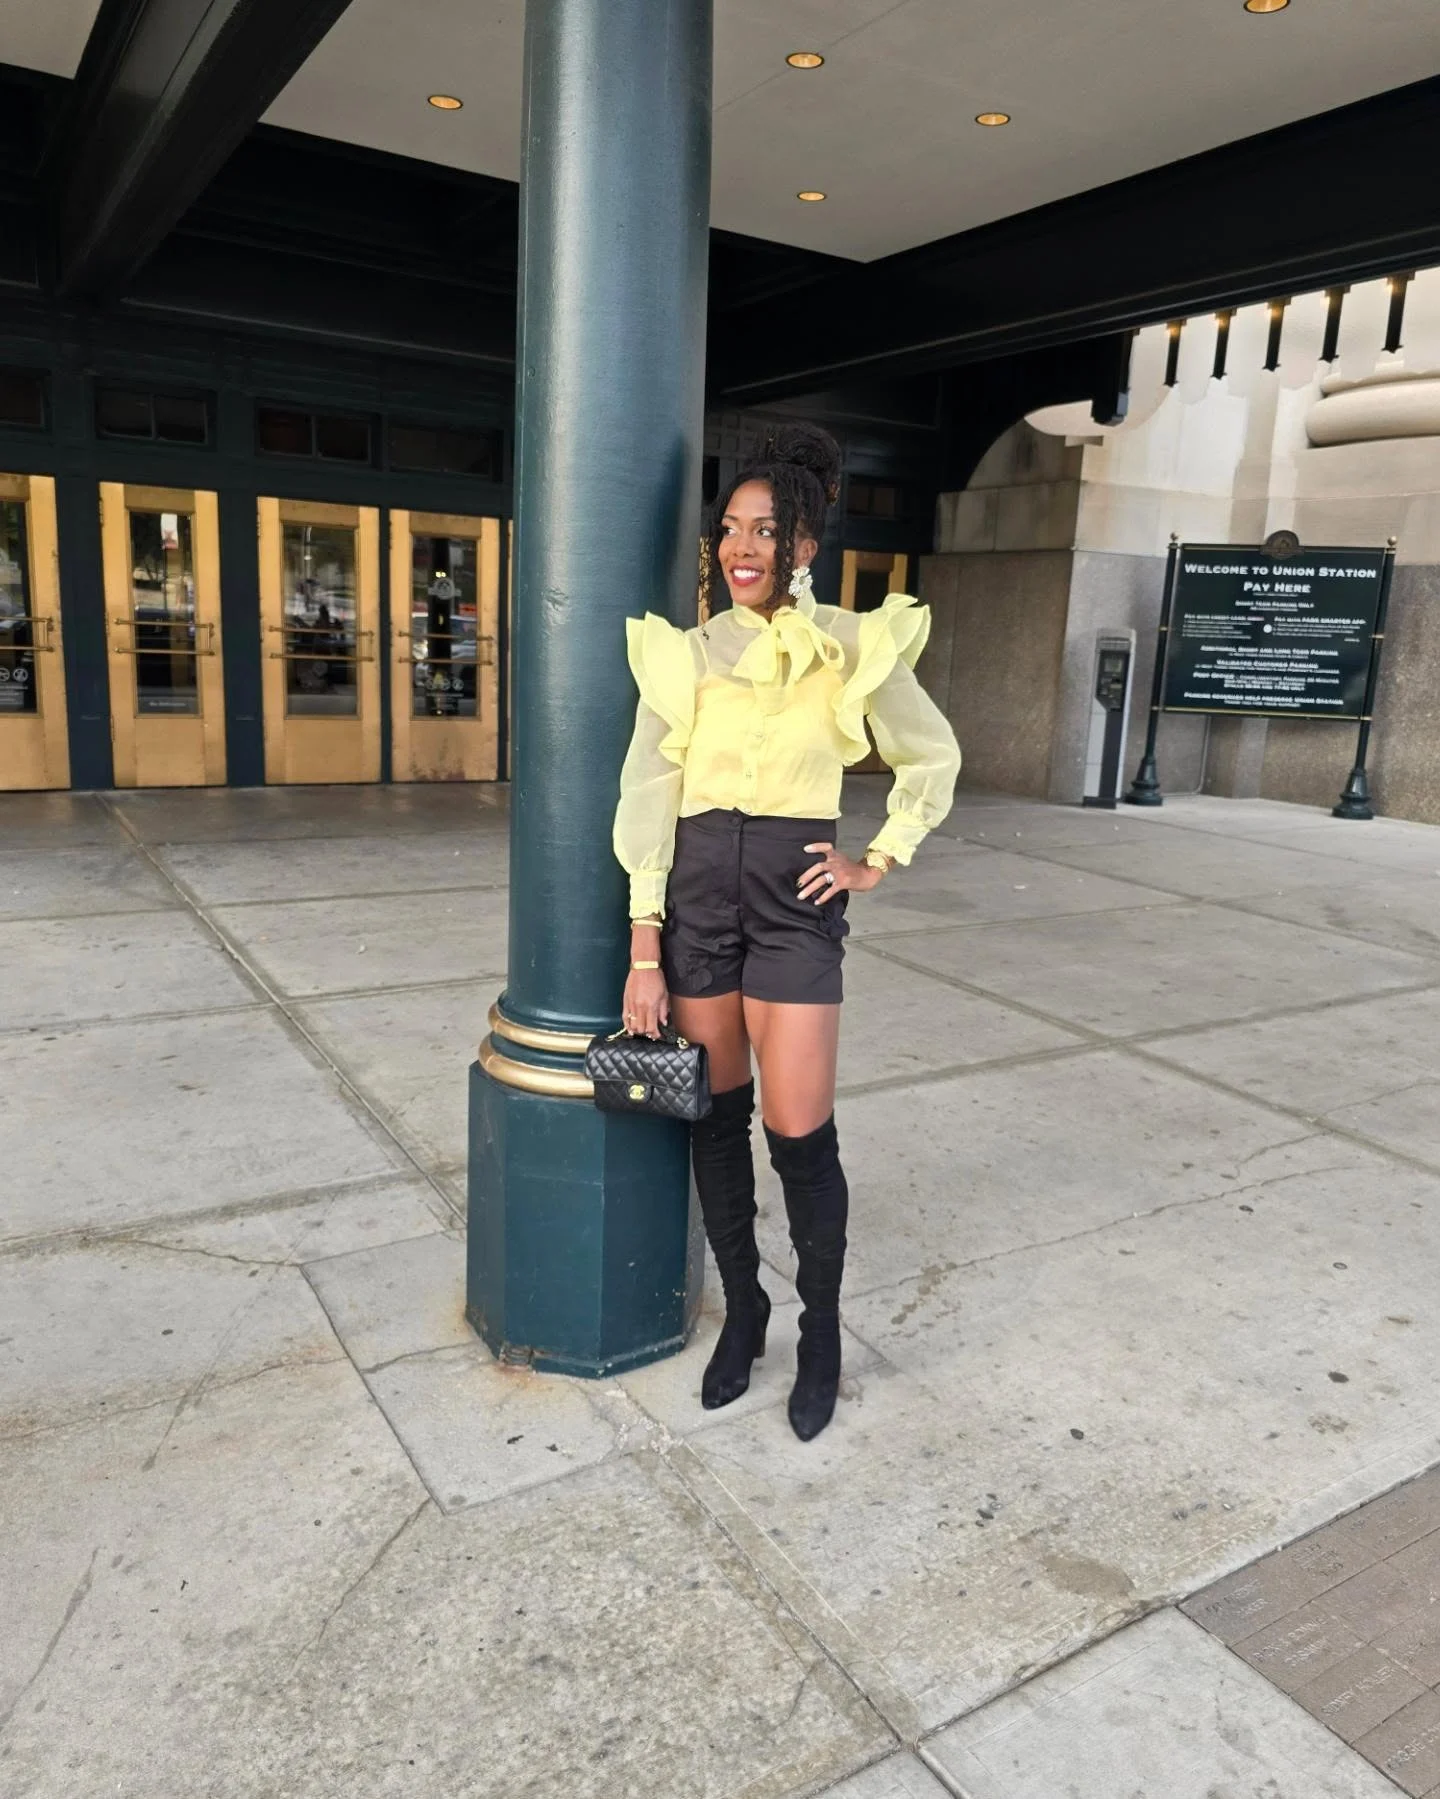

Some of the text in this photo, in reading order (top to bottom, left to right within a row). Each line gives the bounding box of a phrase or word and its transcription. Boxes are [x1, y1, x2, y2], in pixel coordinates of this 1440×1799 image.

[1184, 563, 1377, 578] WELCOME TO UNION STATION
[1243, 581, 1312, 593] PAY HERE
